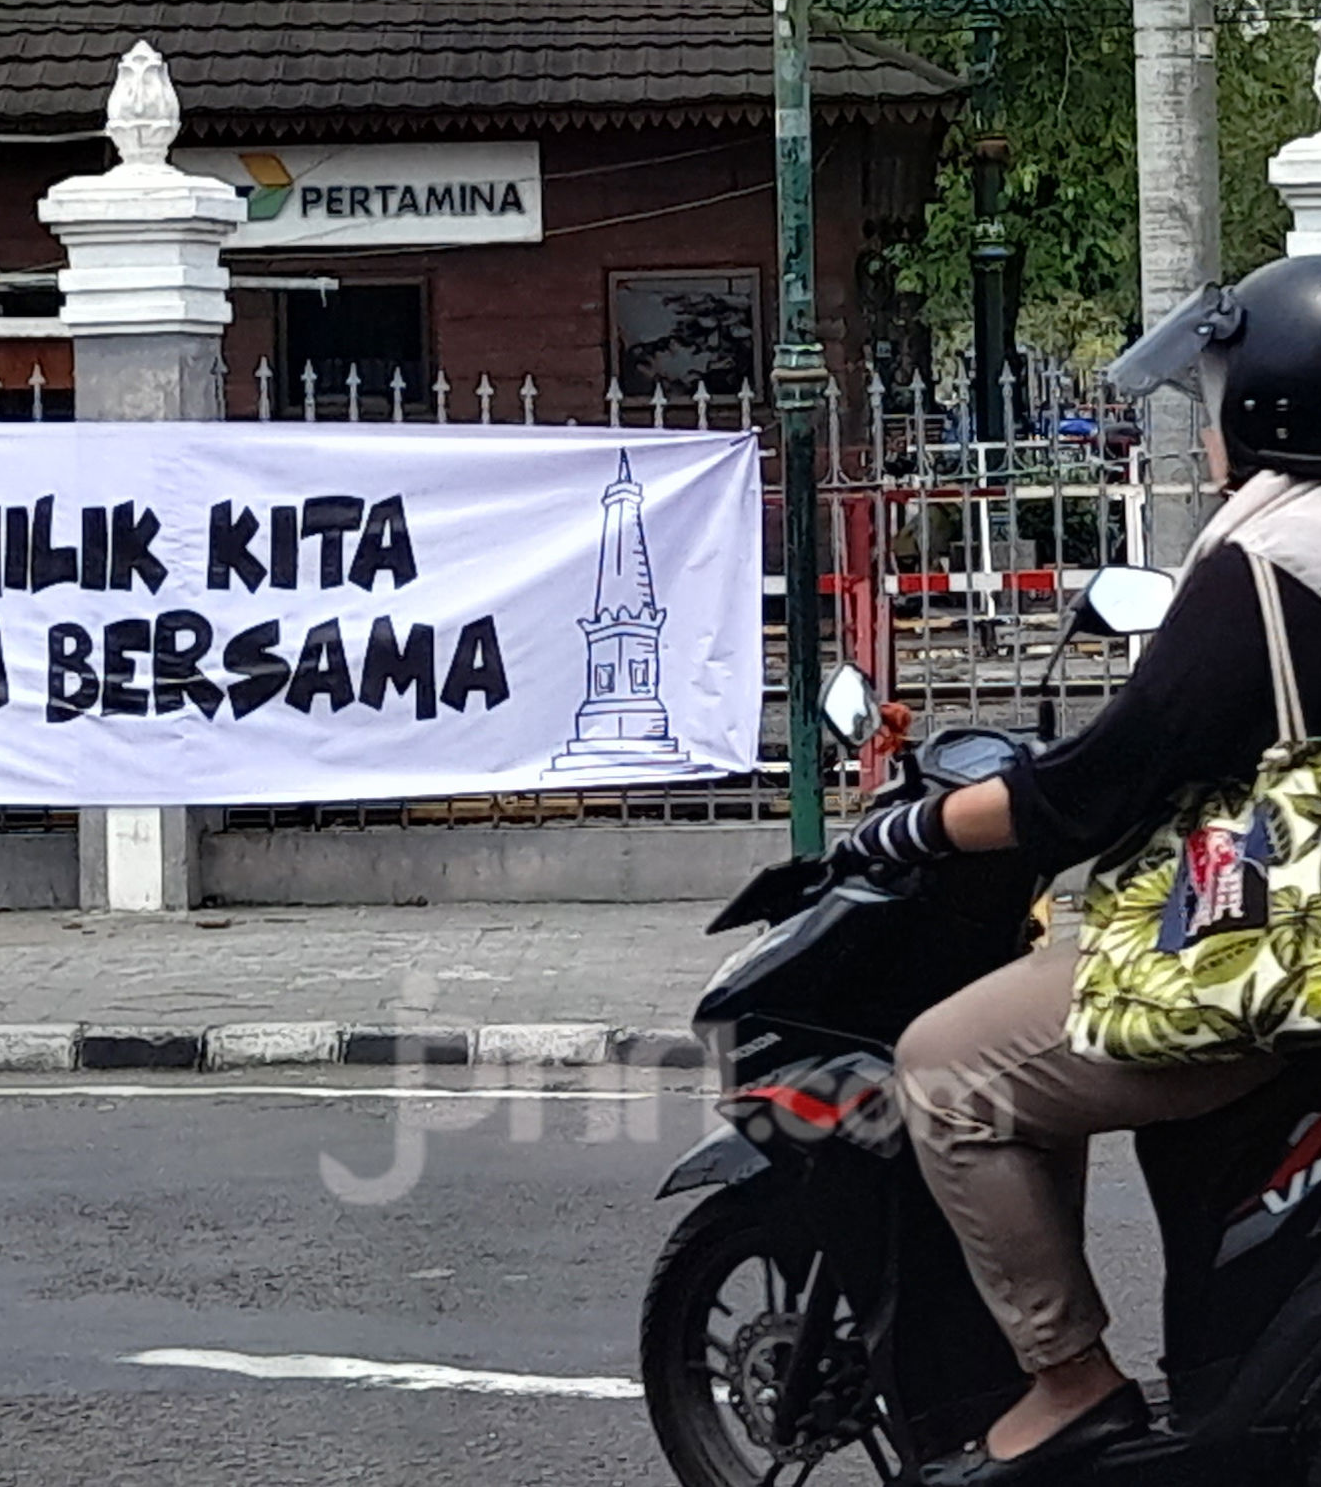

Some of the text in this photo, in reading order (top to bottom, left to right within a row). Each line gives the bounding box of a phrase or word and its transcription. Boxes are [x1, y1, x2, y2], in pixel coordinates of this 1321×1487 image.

[300, 180, 527, 220] PERTAMINA
[208, 494, 419, 594] KITA
[46, 610, 510, 723] BERSAMA
